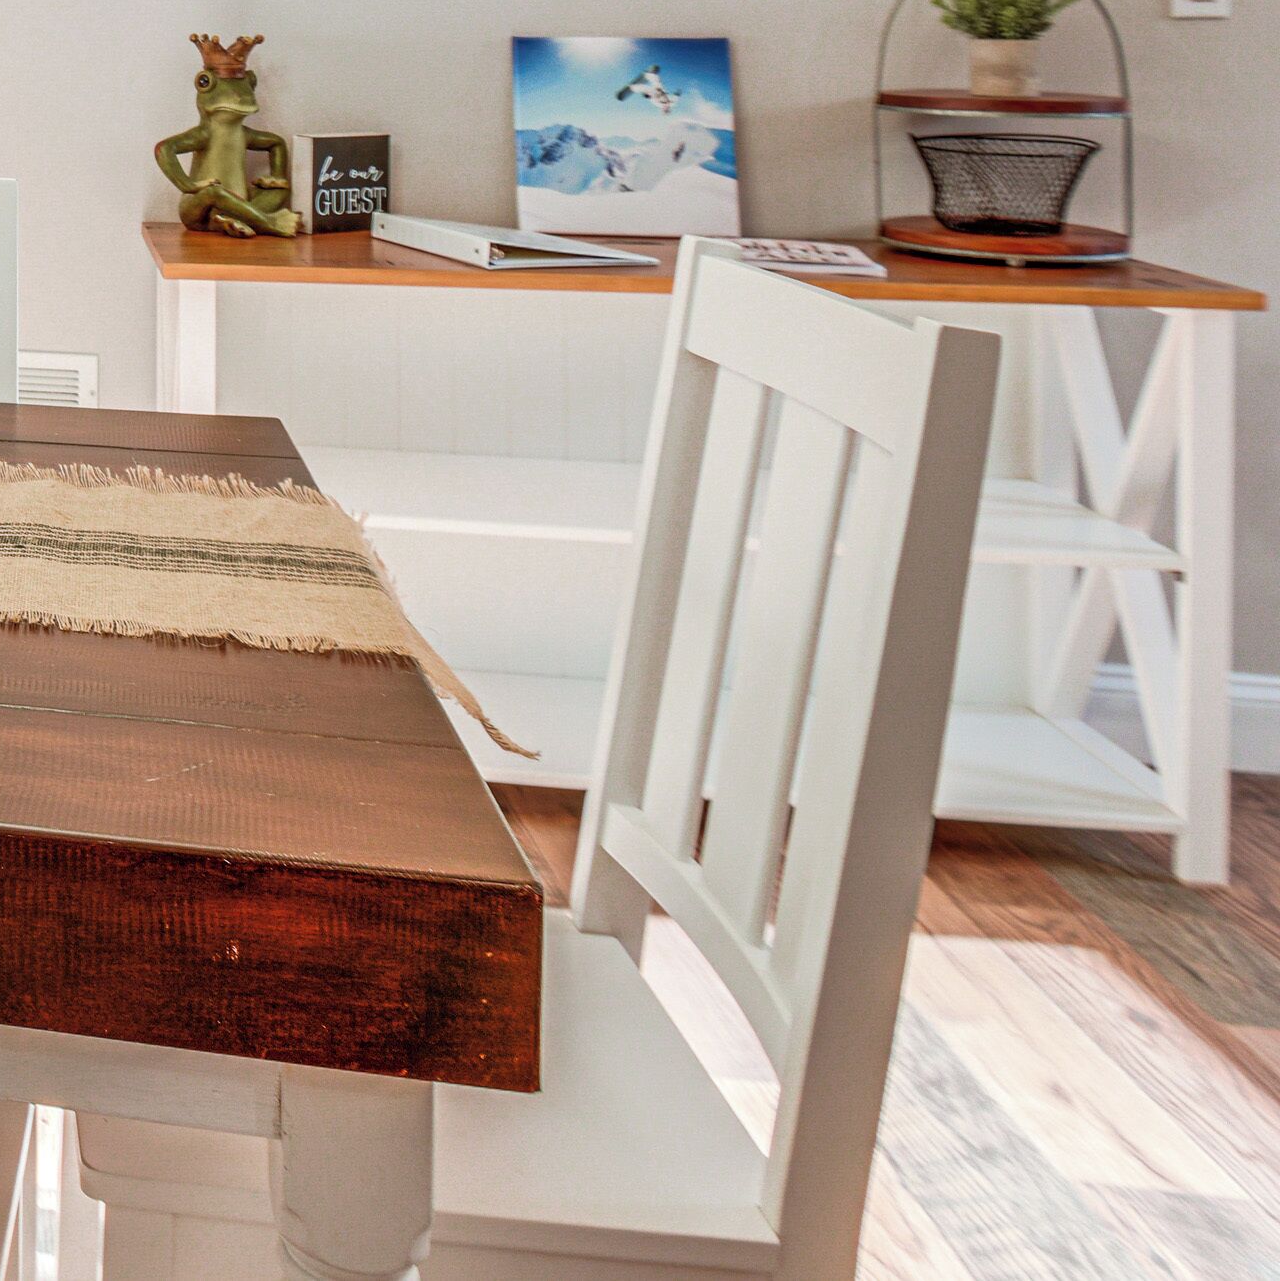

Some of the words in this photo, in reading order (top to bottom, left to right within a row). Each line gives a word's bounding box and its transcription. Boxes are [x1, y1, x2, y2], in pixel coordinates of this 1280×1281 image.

[318, 155, 344, 186] be
[348, 165, 384, 182] our
[315, 187, 387, 216] GUEST
